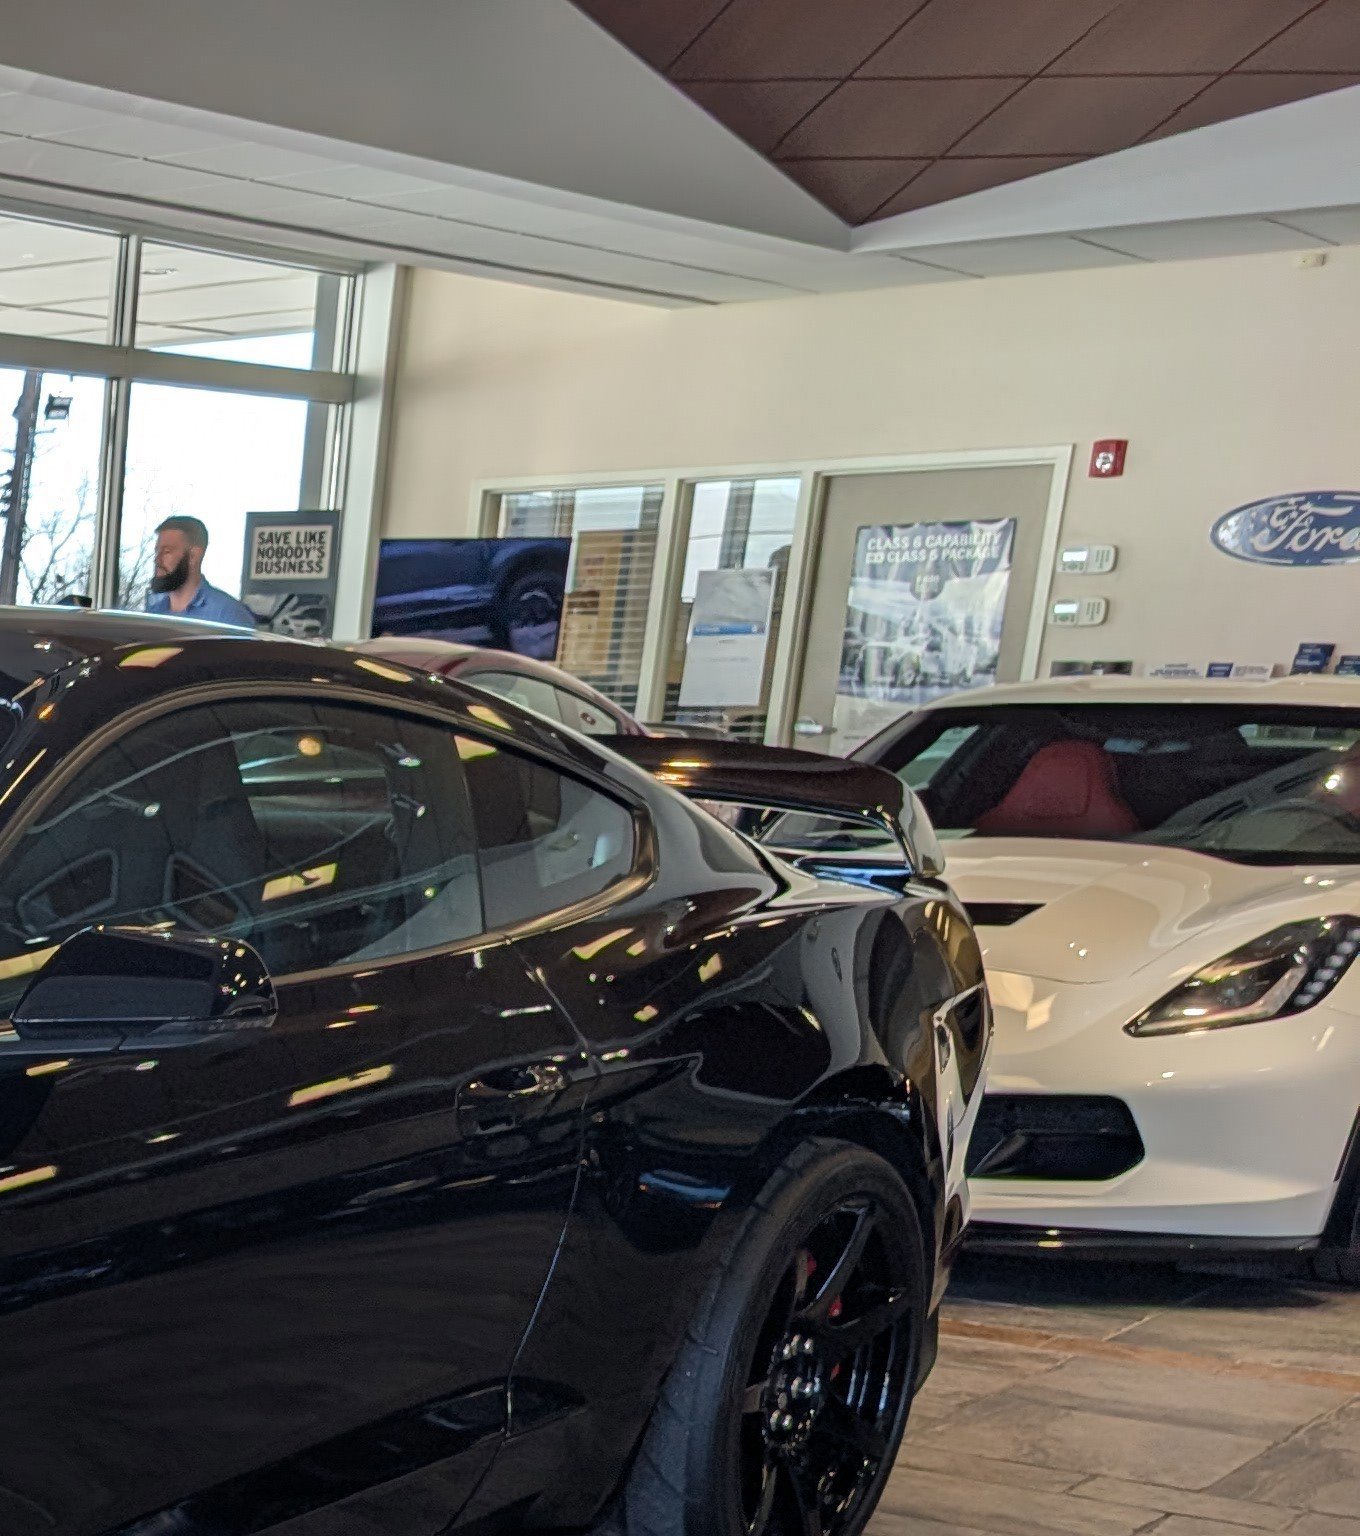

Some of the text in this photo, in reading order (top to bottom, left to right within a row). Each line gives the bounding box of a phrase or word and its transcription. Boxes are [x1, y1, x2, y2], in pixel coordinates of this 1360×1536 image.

[258, 530, 327, 545] SAVE LIKE
[867, 535, 909, 550] CLASS
[257, 545, 325, 559] NOBODY'S
[887, 548, 926, 563] CLASS
[941, 545, 1000, 561] PACKAGE
[255, 560, 323, 574] BUSINESS
